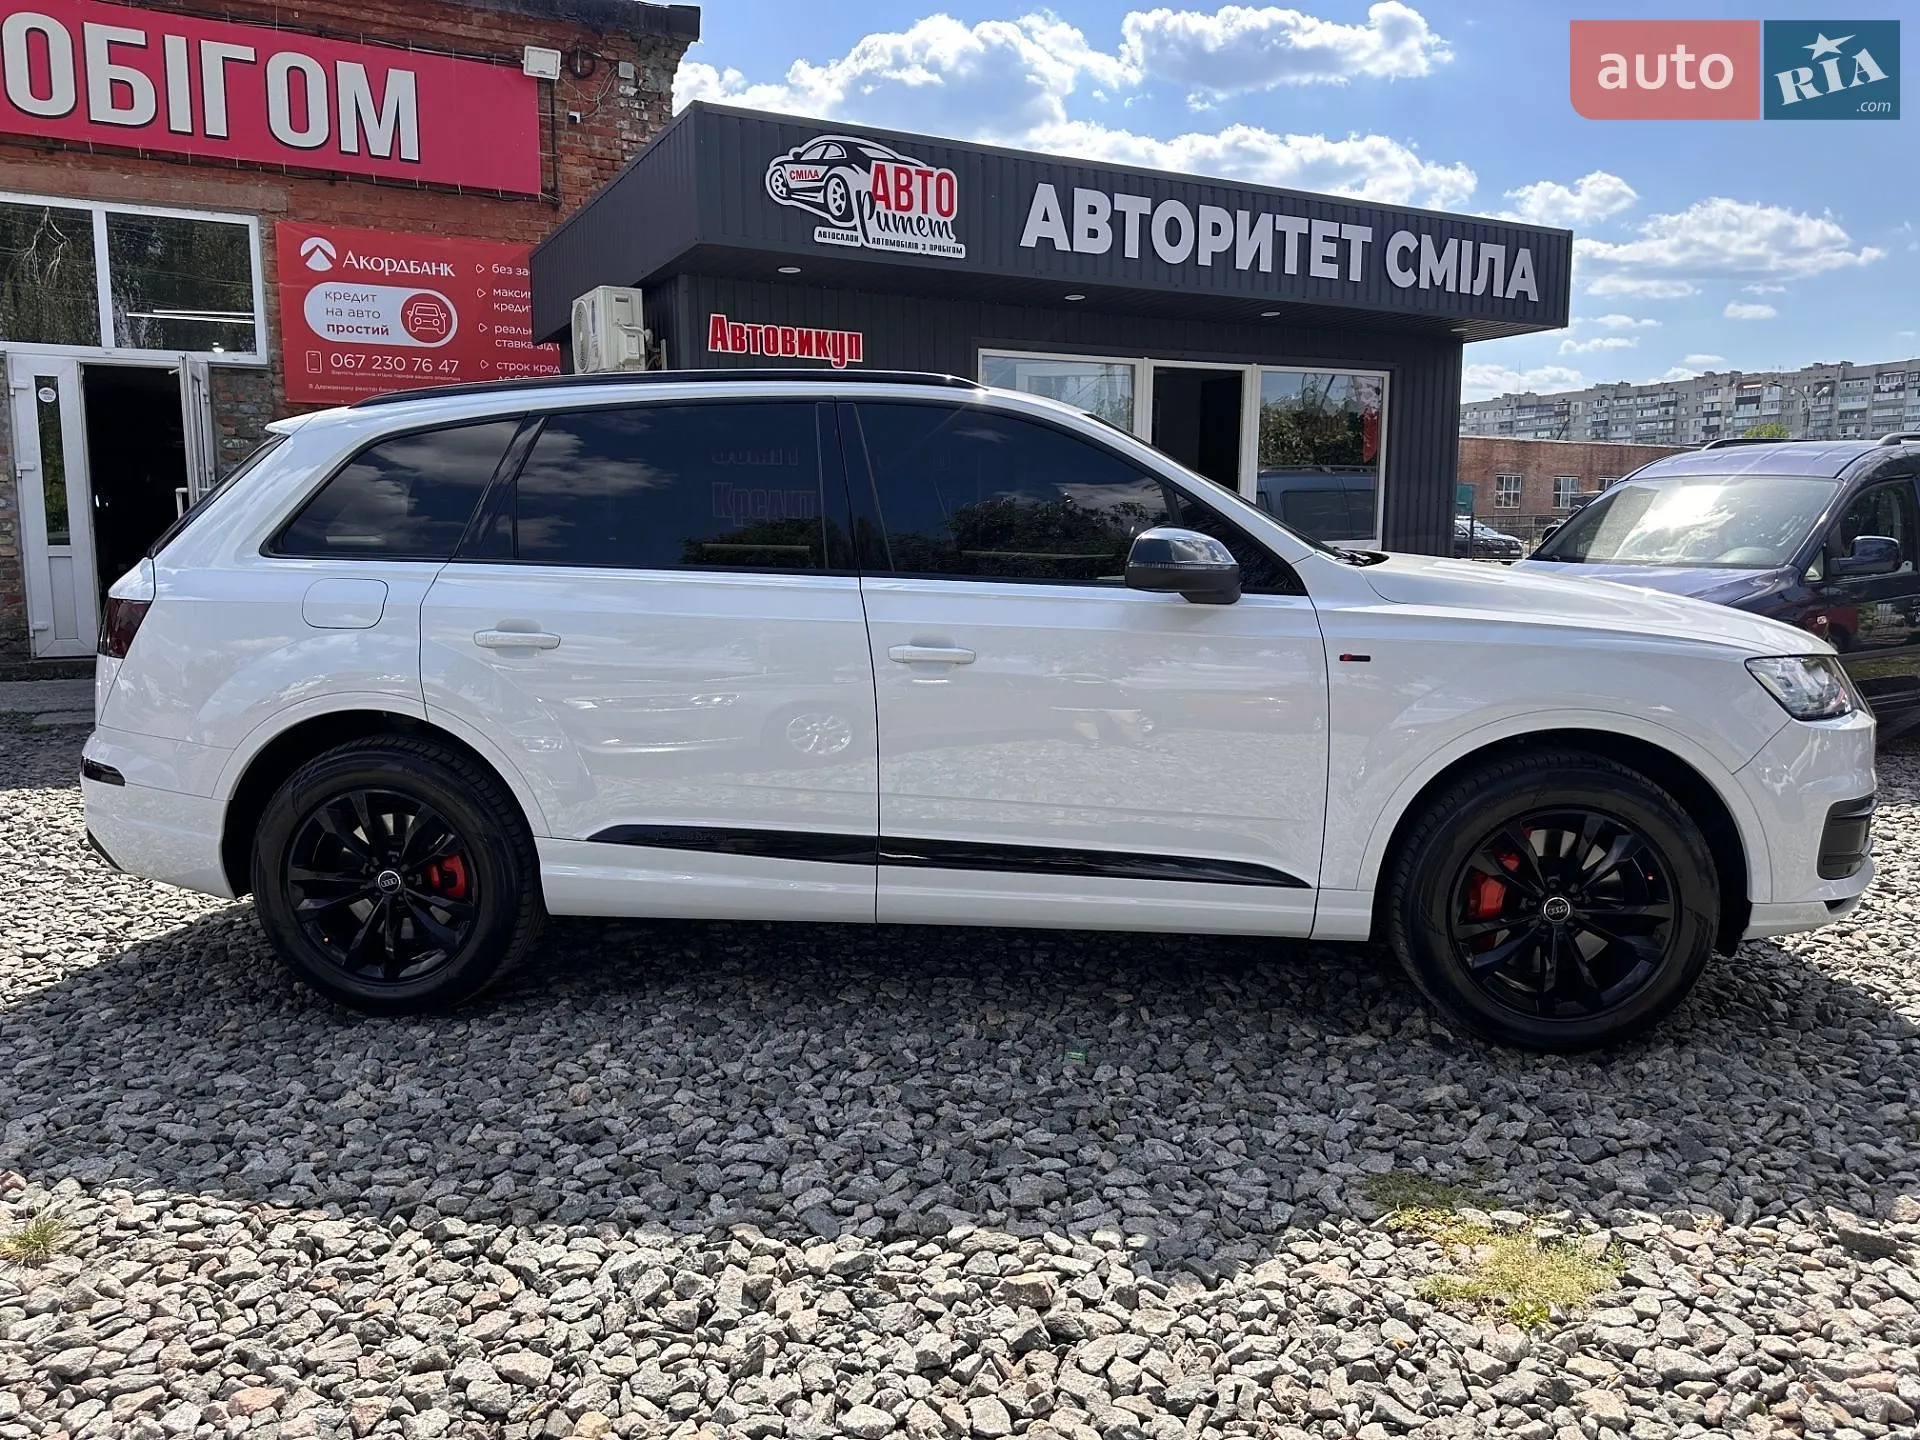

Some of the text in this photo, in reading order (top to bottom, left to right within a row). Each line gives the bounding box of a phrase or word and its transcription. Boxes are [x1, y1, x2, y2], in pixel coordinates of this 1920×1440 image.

[2, 12, 420, 162] ОБІГОМ
[789, 168, 820, 181] СМІЛА
[872, 162, 955, 218] АВТО
[817, 230, 859, 243] АВТОСАЛОН
[1019, 183, 1538, 302] АВТОРИТЕТ СМІЛА
[492, 263, 531, 276] без за
[325, 290, 377, 303] кредит
[326, 308, 381, 319] на авто
[327, 322, 389, 336] простий
[495, 340, 534, 350] ставка
[709, 314, 863, 368] Автовикуп
[330, 352, 459, 374] 067 230 76 47
[496, 361, 530, 372] строк
